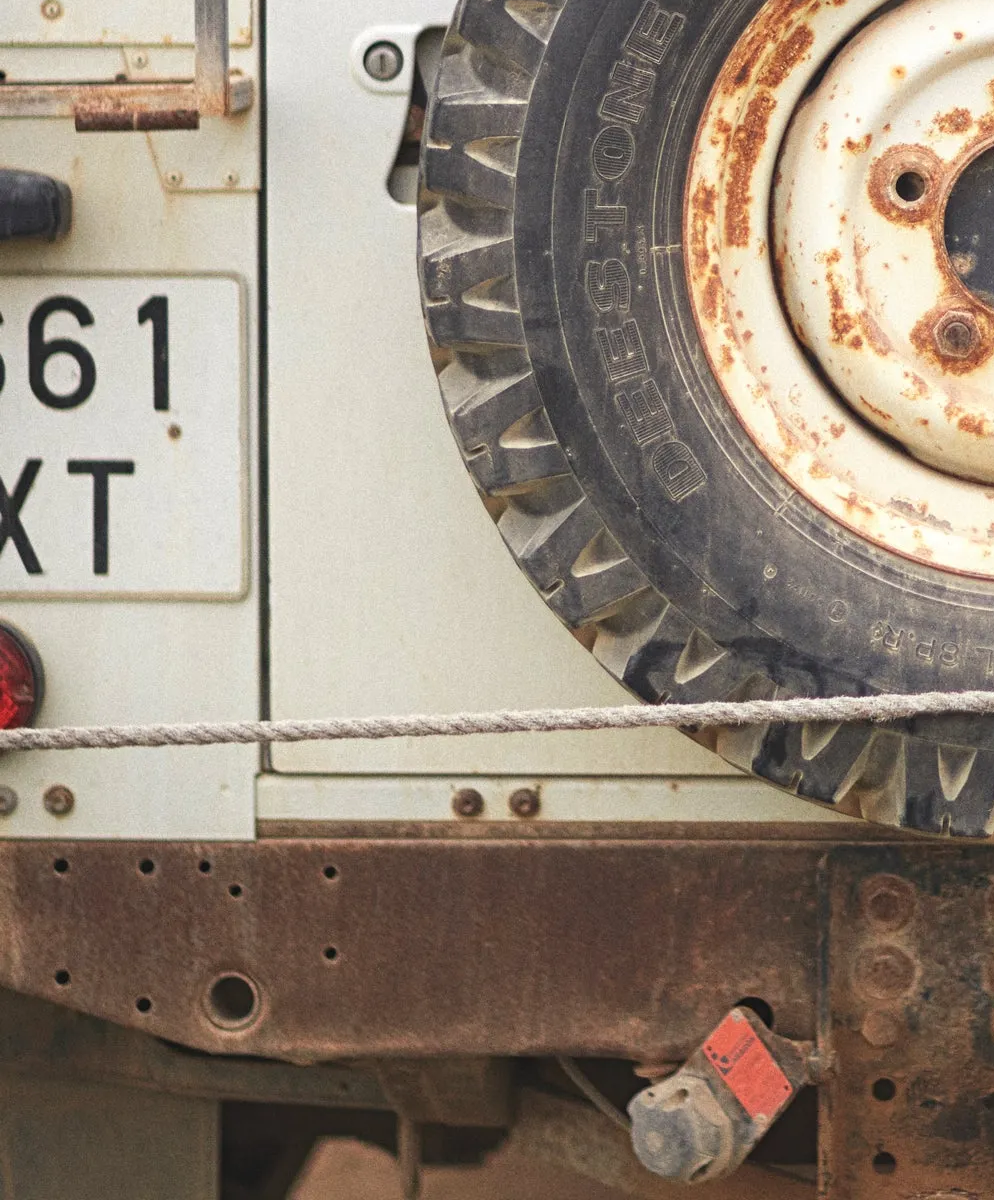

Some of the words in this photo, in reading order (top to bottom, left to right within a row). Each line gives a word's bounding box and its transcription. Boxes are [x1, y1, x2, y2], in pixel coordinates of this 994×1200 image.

[584, 0, 708, 502] DEESTONE
[0, 295, 170, 412] 61
[0, 458, 135, 576] XT
